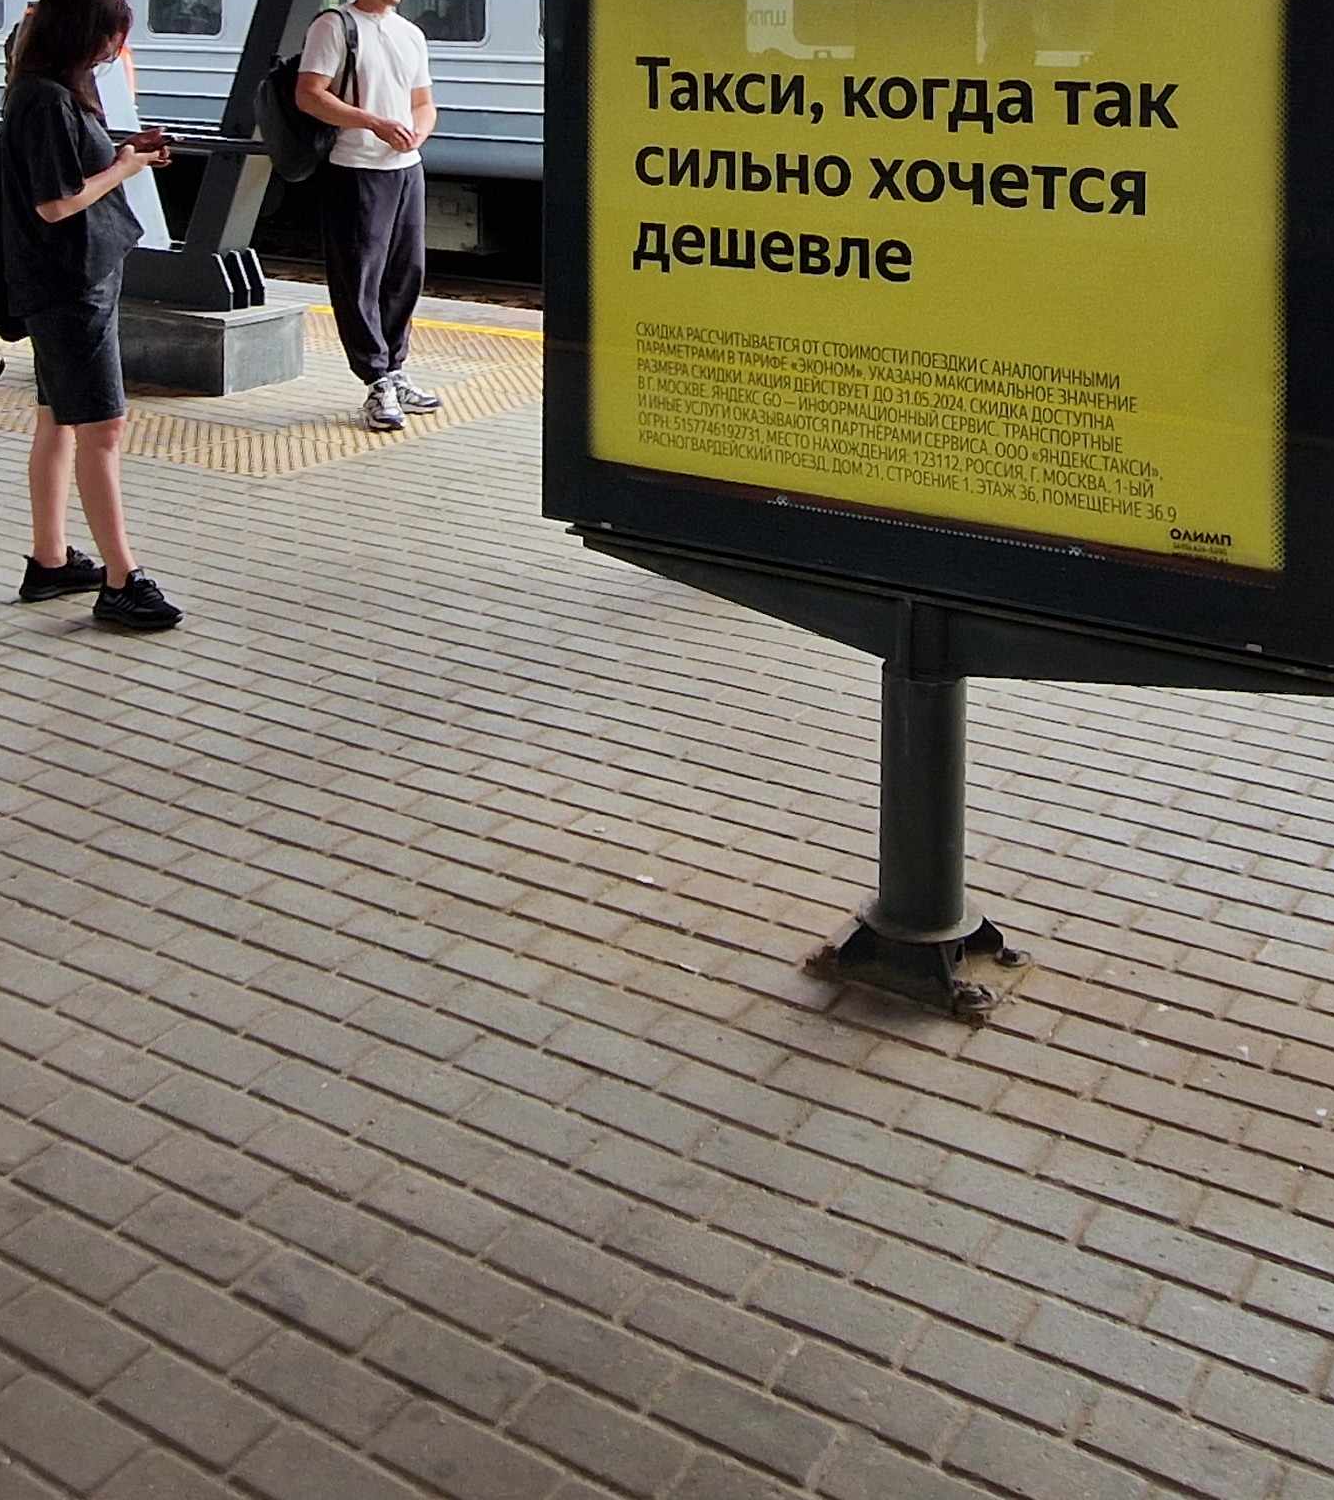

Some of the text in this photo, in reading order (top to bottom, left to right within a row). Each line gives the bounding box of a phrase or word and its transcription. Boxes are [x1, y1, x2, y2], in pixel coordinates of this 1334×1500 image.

[635, 56, 1179, 134] Такси, когда так
[634, 145, 1148, 216] сильно хочется
[632, 220, 914, 283] дешевле
[636, 322, 1120, 390] СКИДКА РАССЧИТЫВАЕТСЯ ОТ СТОИМОСТИ ПОЕЗДКИ С АНАЛОГИЧНЫМИ
[637, 340, 725, 363] ПАРАМЕТРАМИ
[728, 350, 736, 365] В
[739, 351, 788, 371] ТАРИФЕ
[868, 366, 932, 387] УКАЗАНО
[935, 373, 1055, 404] МАКСИМАЛЬНОЕ
[1058, 388, 1139, 413] ЗНАЧЕНИЕ
[637, 358, 689, 378] РАЗМЕРА
[747, 372, 791, 390] АКЦИЯ
[794, 375, 869, 400] ДЕЙСТВУЕТ
[873, 386, 893, 403] ДО
[970, 398, 1029, 420] СКИДКА
[1031, 406, 1115, 431] ДОСТУПНА
[638, 376, 645, 390] В
[711, 385, 760, 405] ЯНДЕКС
[763, 392, 782, 408] GO
[798, 396, 939, 428] ИНФОРМАЦИОННЫЙ
[1002, 422, 1124, 454] ТРАНСПОРТНЫЕ
[638, 394, 647, 407] И
[649, 395, 682, 413] ИНЫЕ
[685, 401, 731, 419] УСЛУГИ
[733, 406, 829, 433] ОКАЗЫВАЮТСЯ
[832, 420, 922, 446] ПАРТНЕРАМИ
[995, 442, 1028, 461] ООО
[639, 429, 773, 462] КРАСНОГВАРДЕЙСКИЙ
[832, 457, 863, 476] ДОМ
[886, 465, 961, 490] СТРОЕНИЕ
[977, 478, 1017, 499] ЭТАЖ
[1042, 488, 1143, 518] ПОМЕЩЕНИЕ
[767, 431, 810, 450] МЕСТО
[1115, 478, 1154, 499] 1-ЫЙ
[1170, 528, 1232, 546] ОЛИМП
